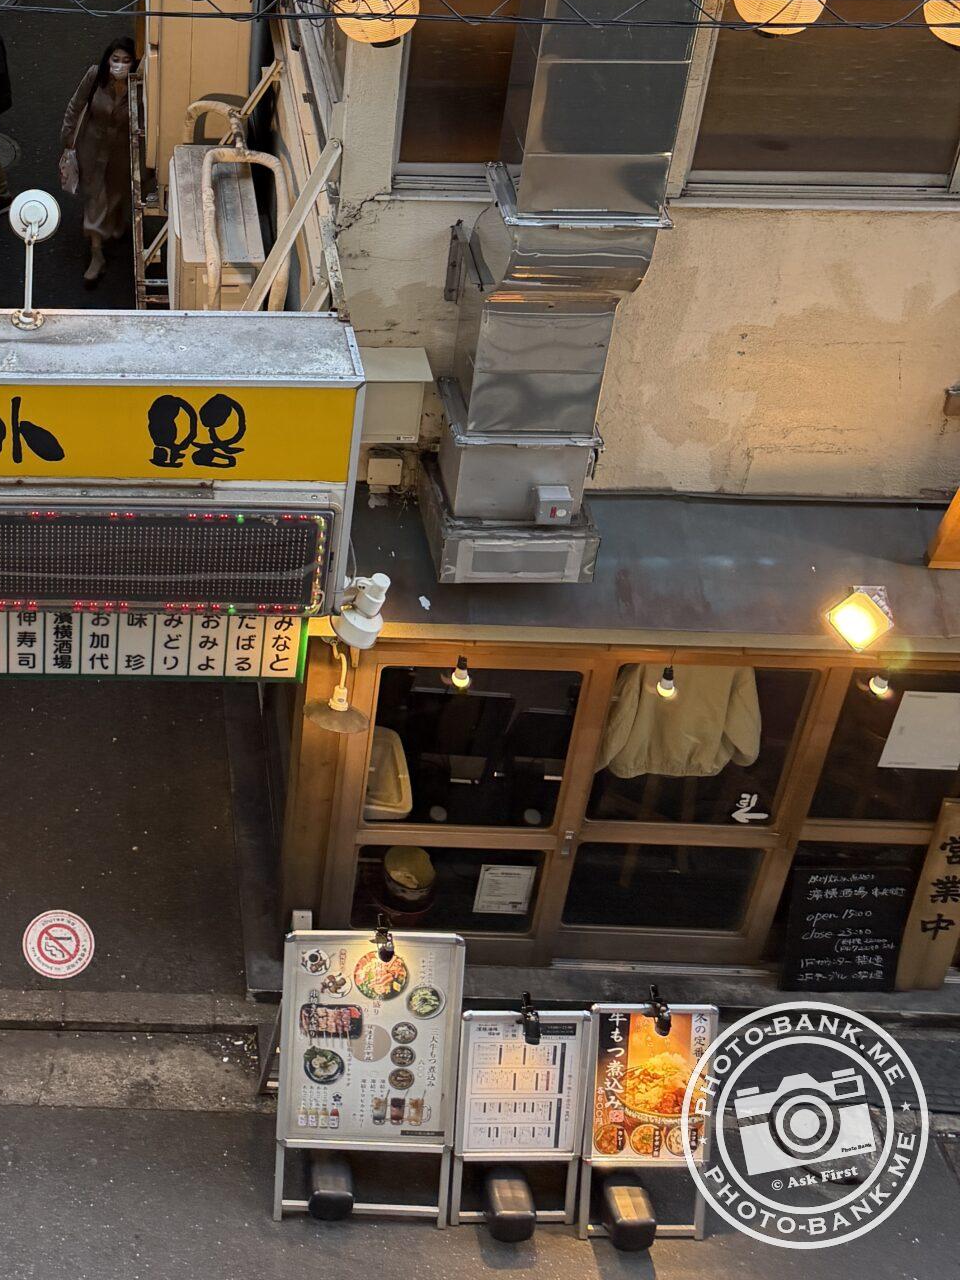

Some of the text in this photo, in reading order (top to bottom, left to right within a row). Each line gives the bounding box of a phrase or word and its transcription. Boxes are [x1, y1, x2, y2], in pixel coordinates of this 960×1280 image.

[16, 611, 37, 669] 伸寿司
[89, 611, 110, 670] お加代
[125, 612, 146, 670] 味珍
[162, 613, 183, 670] みどり
[197, 613, 220, 671] おみよ
[269, 615, 294, 672] みなと
[802, 928, 833, 940] close
[806, 912, 838, 927] open
[603, 1013, 628, 1109] 牛もつ煮込み
[694, 1013, 708, 1064] 冬の定番
